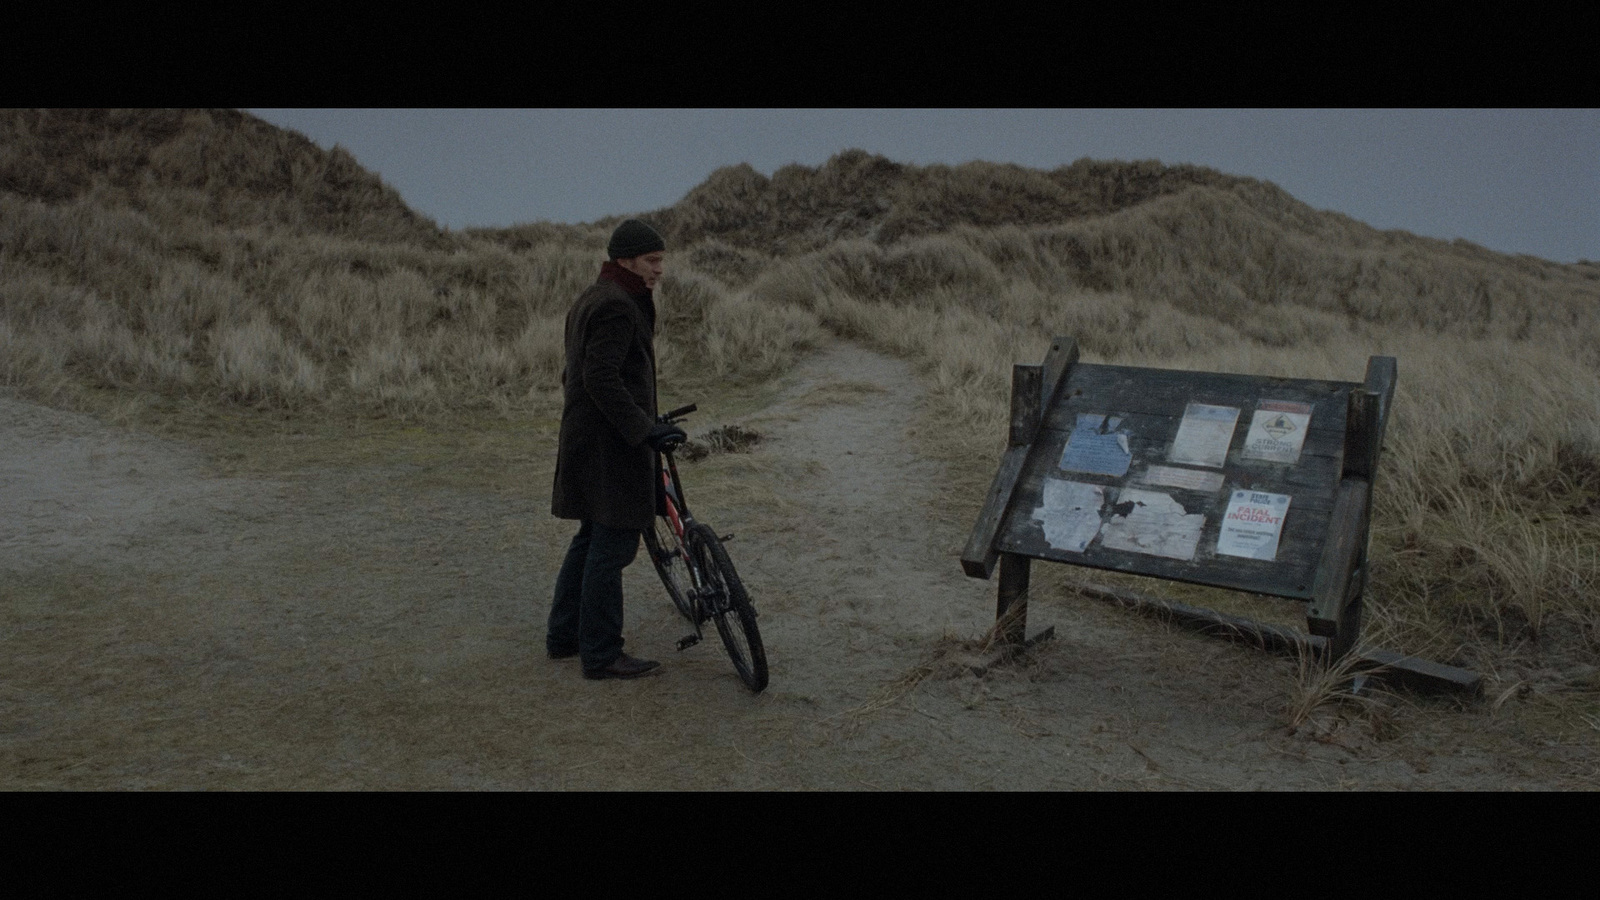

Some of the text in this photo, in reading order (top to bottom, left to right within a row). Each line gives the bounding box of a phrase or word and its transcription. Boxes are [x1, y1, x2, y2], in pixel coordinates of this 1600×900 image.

[1255, 438, 1292, 447] STRONG
[1237, 506, 1271, 516] FATAL
[1227, 512, 1282, 525] INCIDENT
